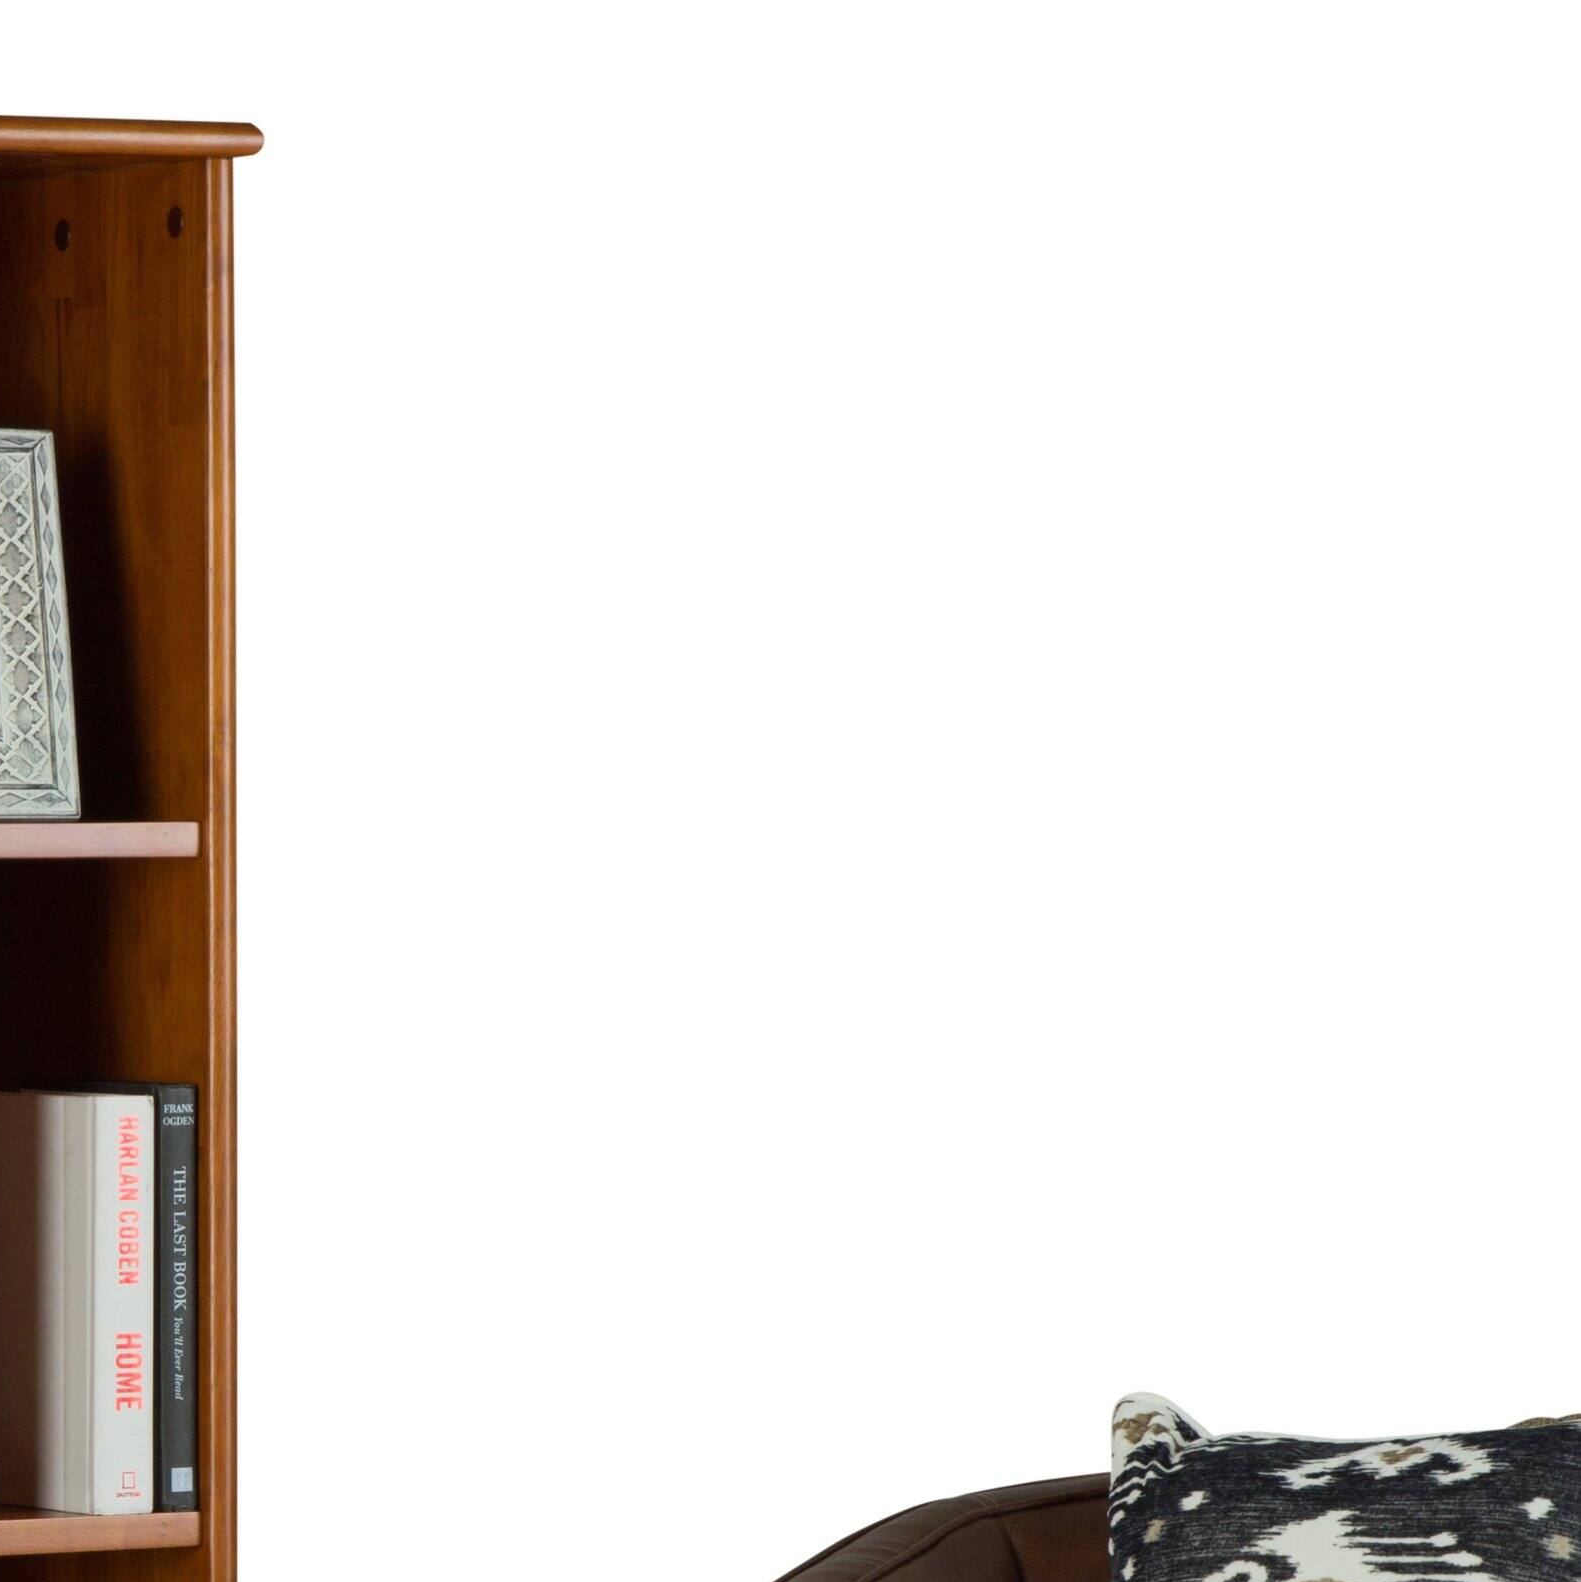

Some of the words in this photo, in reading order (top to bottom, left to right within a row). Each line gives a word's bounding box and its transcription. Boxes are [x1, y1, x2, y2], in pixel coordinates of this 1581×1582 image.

[163, 1103, 194, 1113] FRANK
[163, 1116, 195, 1126] OGDEN
[118, 1116, 140, 1202] HARLAN
[173, 1166, 187, 1205] THE
[118, 1210, 141, 1285] COBEN
[173, 1212, 187, 1256] LAST
[173, 1261, 187, 1311] BOOK
[116, 1333, 142, 1411] HOME
[174, 1349, 184, 1370] Ever
[174, 1373, 185, 1400] Read
